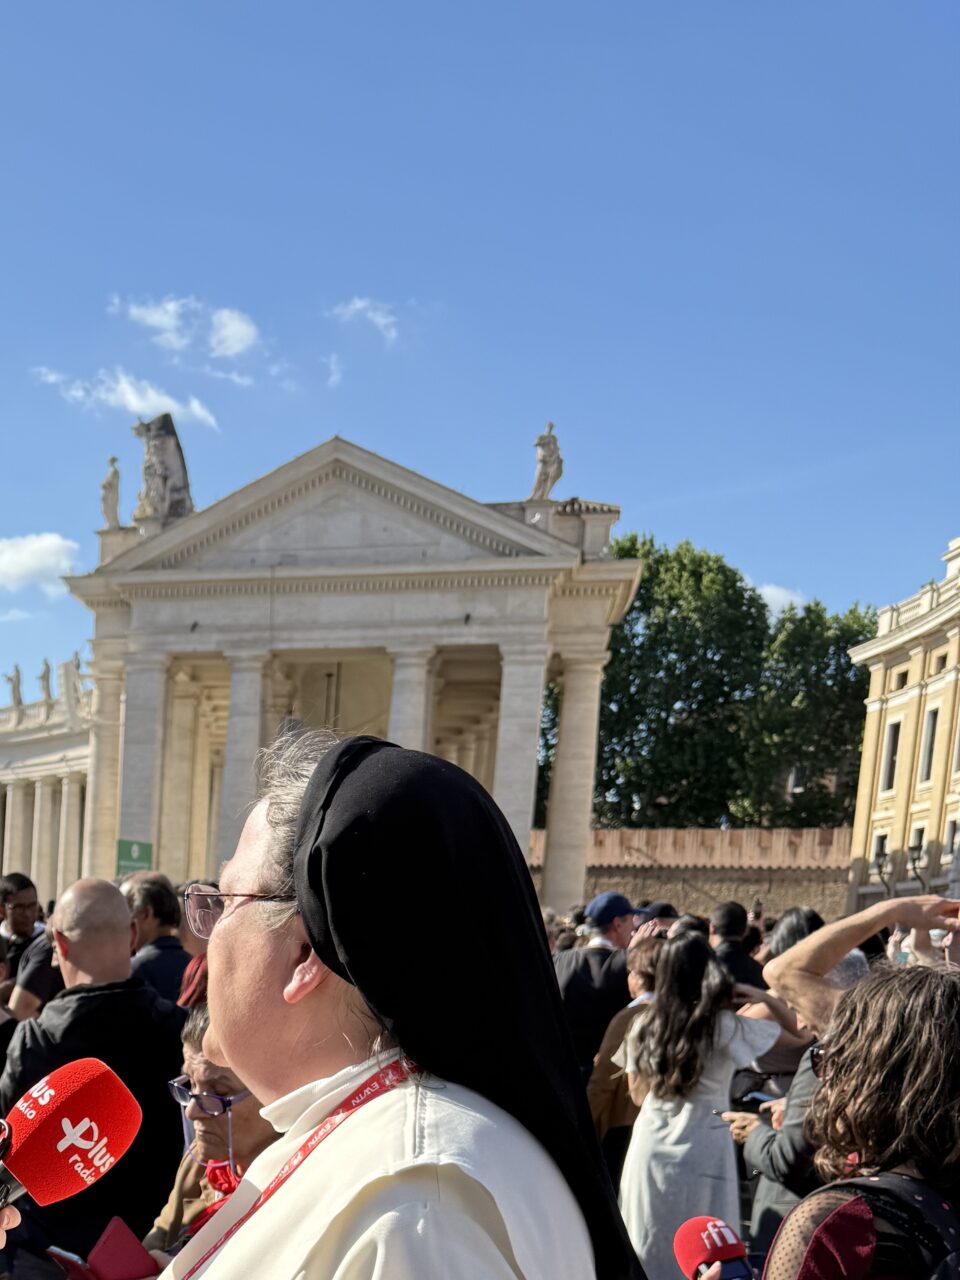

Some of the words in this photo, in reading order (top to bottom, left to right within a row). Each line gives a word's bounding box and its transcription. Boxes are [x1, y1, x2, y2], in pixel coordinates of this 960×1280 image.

[351, 1081, 380, 1106] EWTN
[68, 1153, 96, 1185] radio
[700, 1219, 738, 1250] rfi
